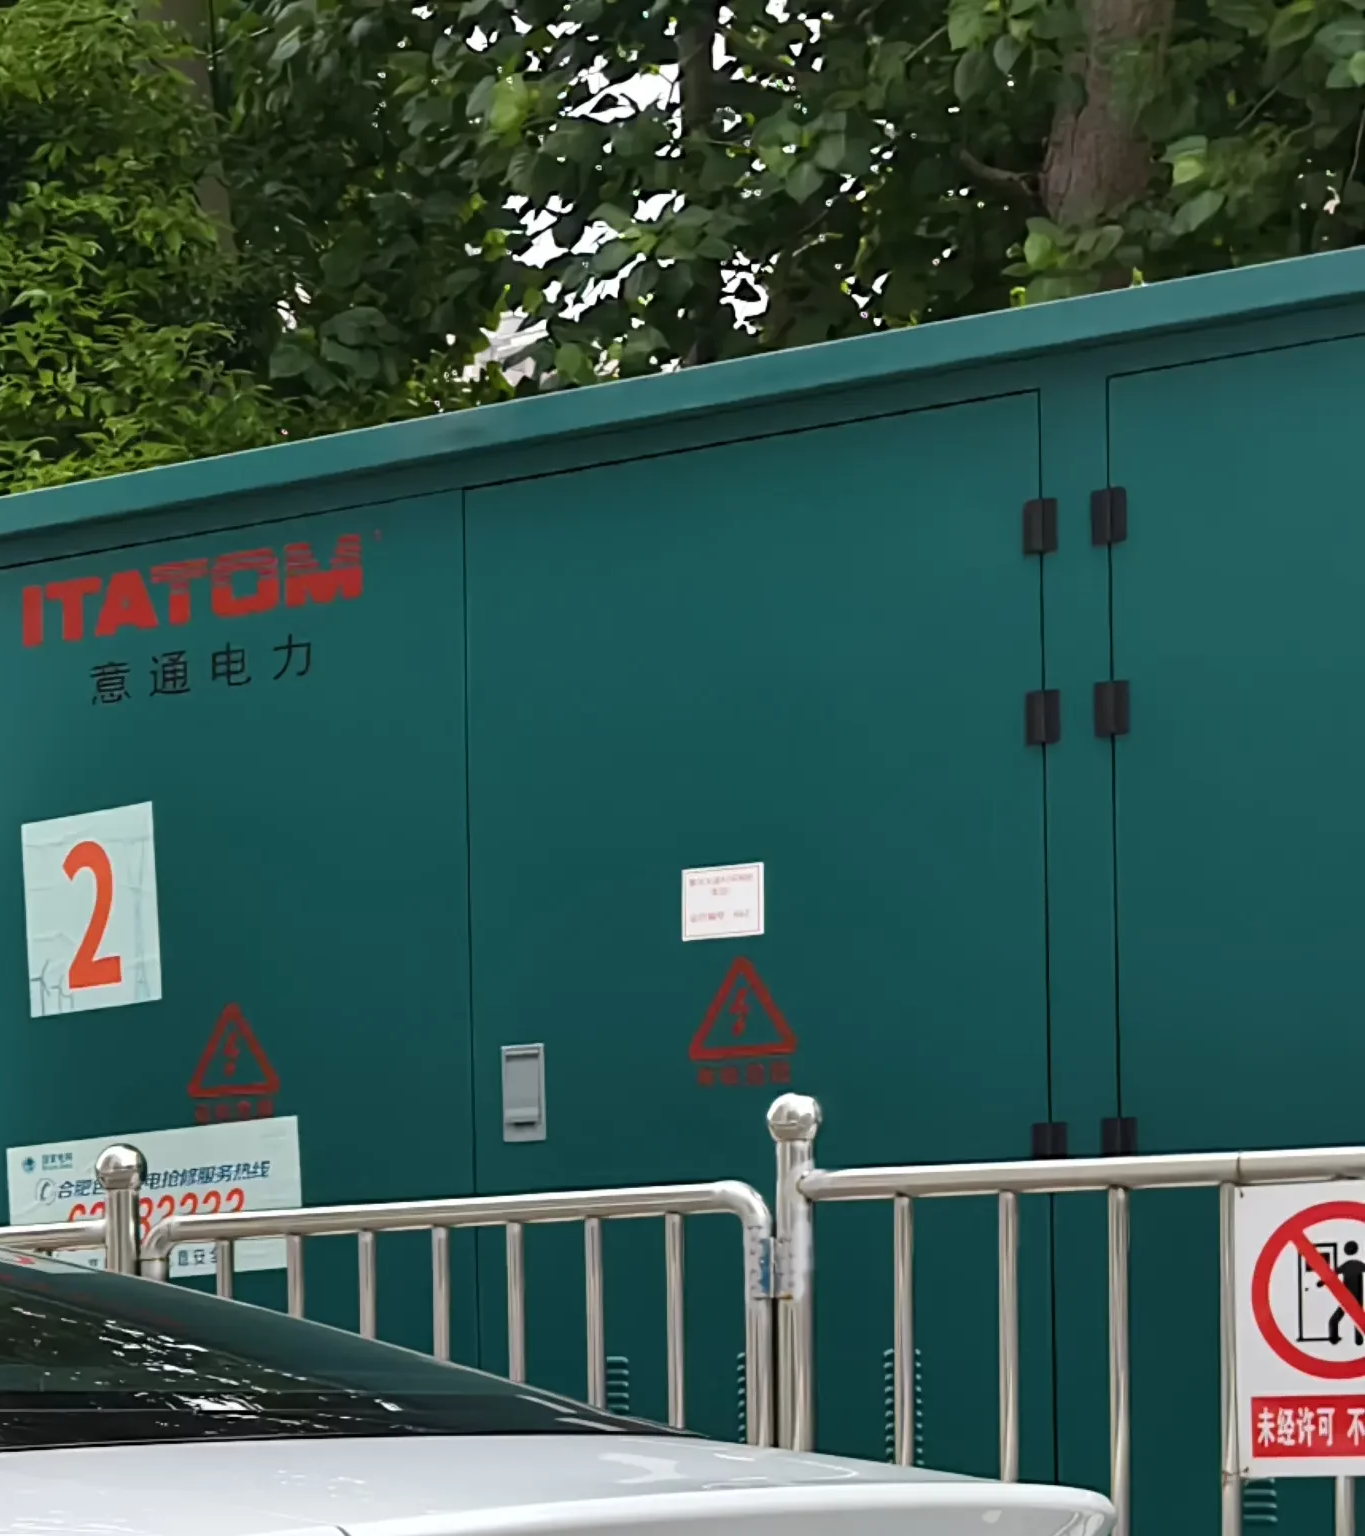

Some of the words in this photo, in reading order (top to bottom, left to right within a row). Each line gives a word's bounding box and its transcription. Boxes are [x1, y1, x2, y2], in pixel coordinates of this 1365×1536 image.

[22, 533, 364, 647] ITATOM
[89, 633, 312, 706] 意通电力
[62, 840, 122, 989] 2
[57, 1160, 271, 1199] 合肥电抢修服务热线
[1257, 1406, 1336, 1447] 未经许可
